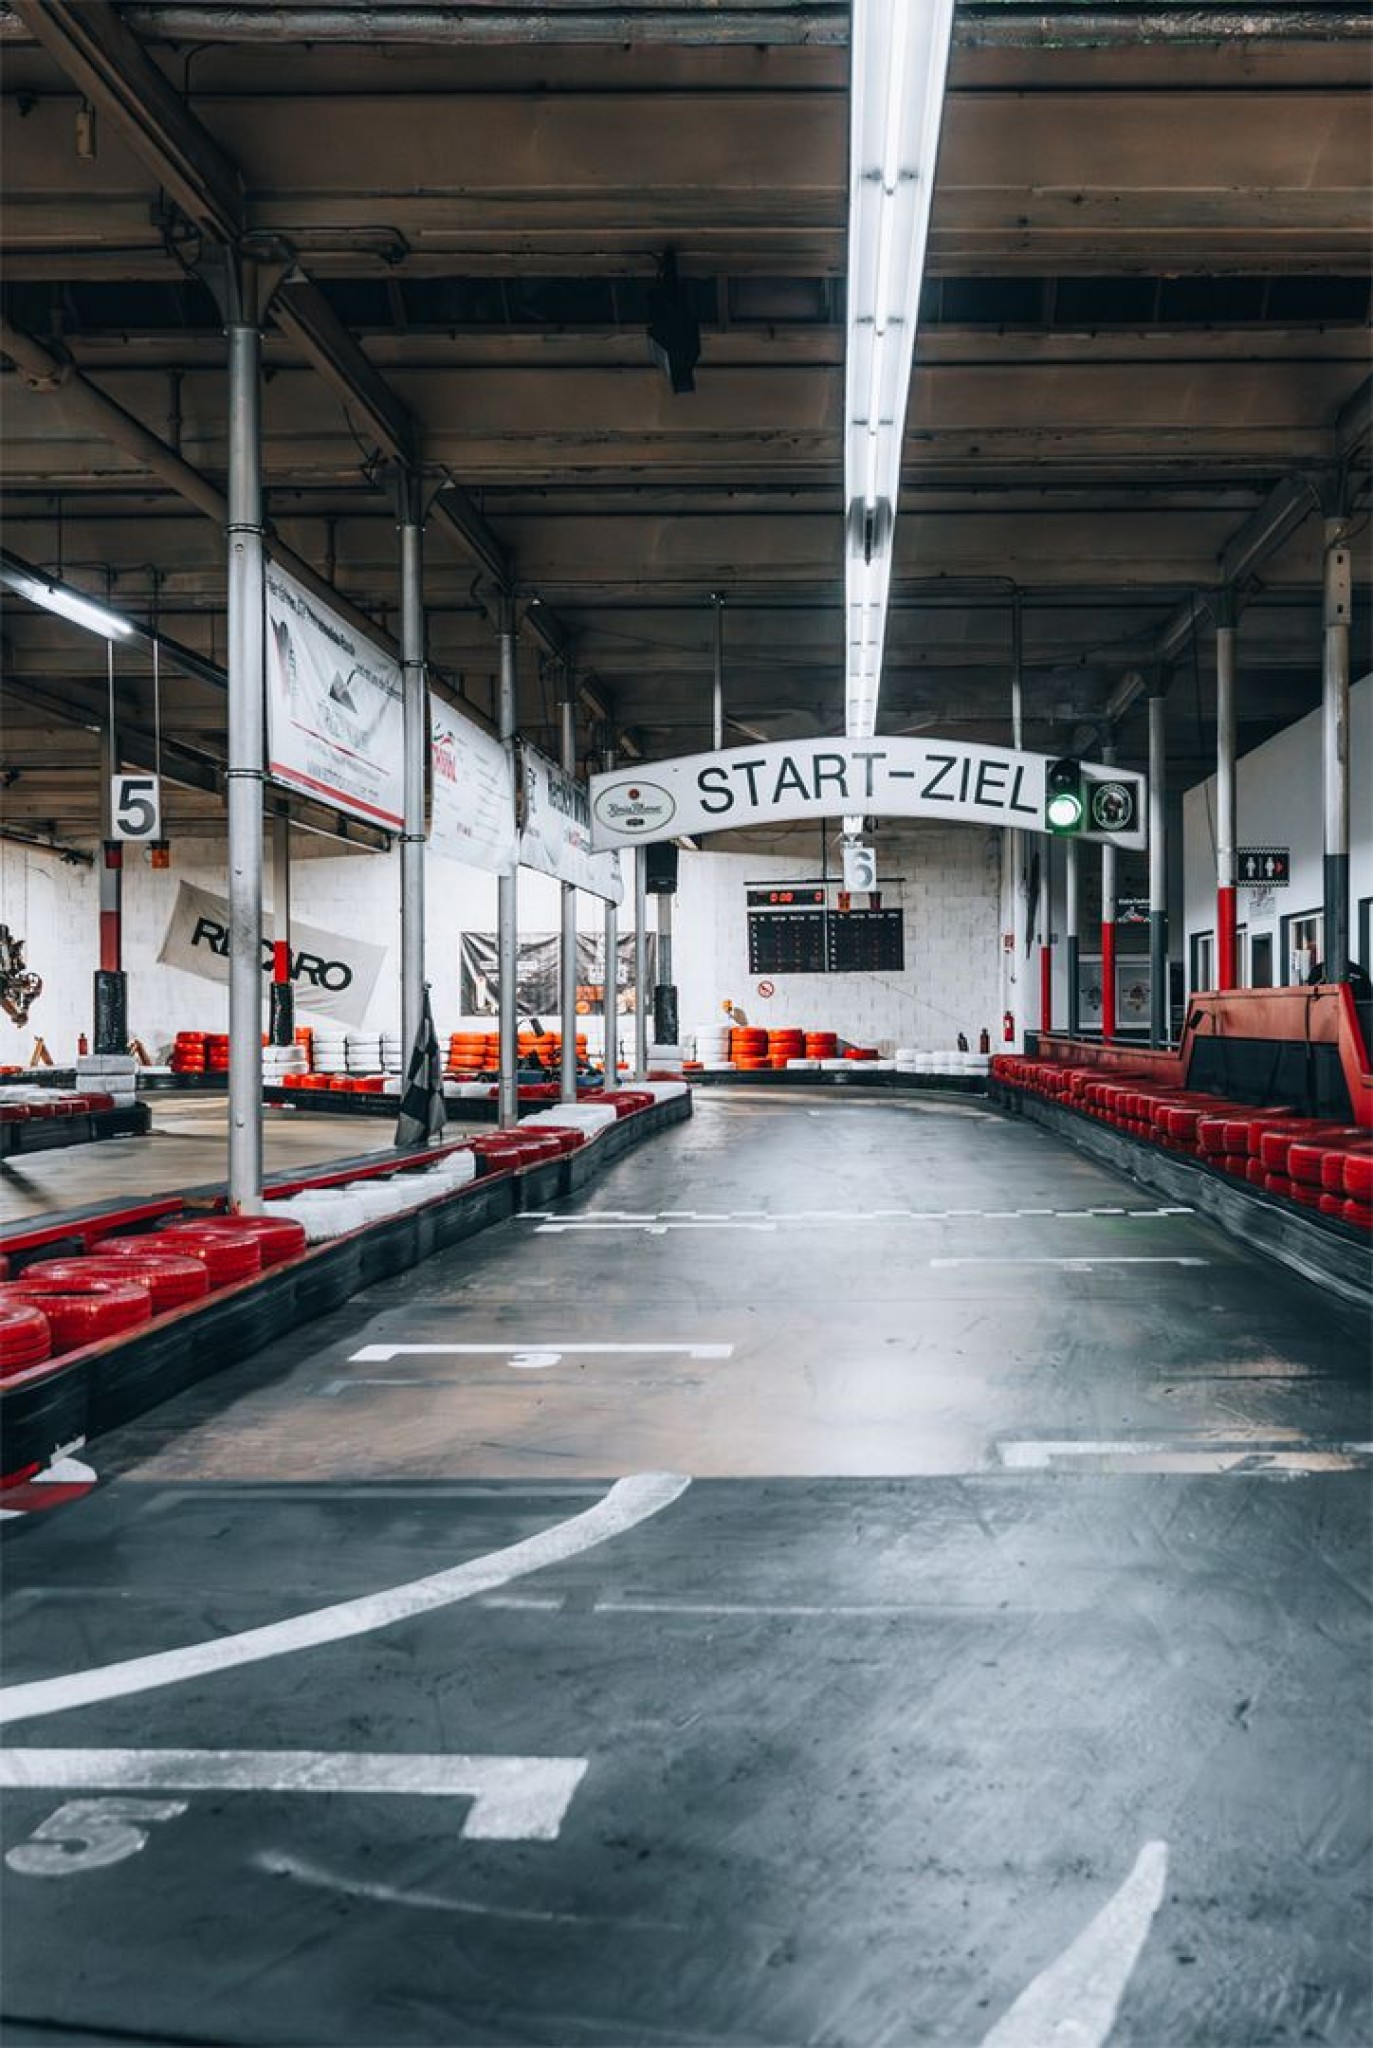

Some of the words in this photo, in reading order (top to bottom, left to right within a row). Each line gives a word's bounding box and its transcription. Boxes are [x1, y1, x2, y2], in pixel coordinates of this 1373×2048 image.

[117, 780, 156, 836] 5
[697, 752, 1038, 815] START-ZIEL
[5, 1797, 189, 1876] 5
